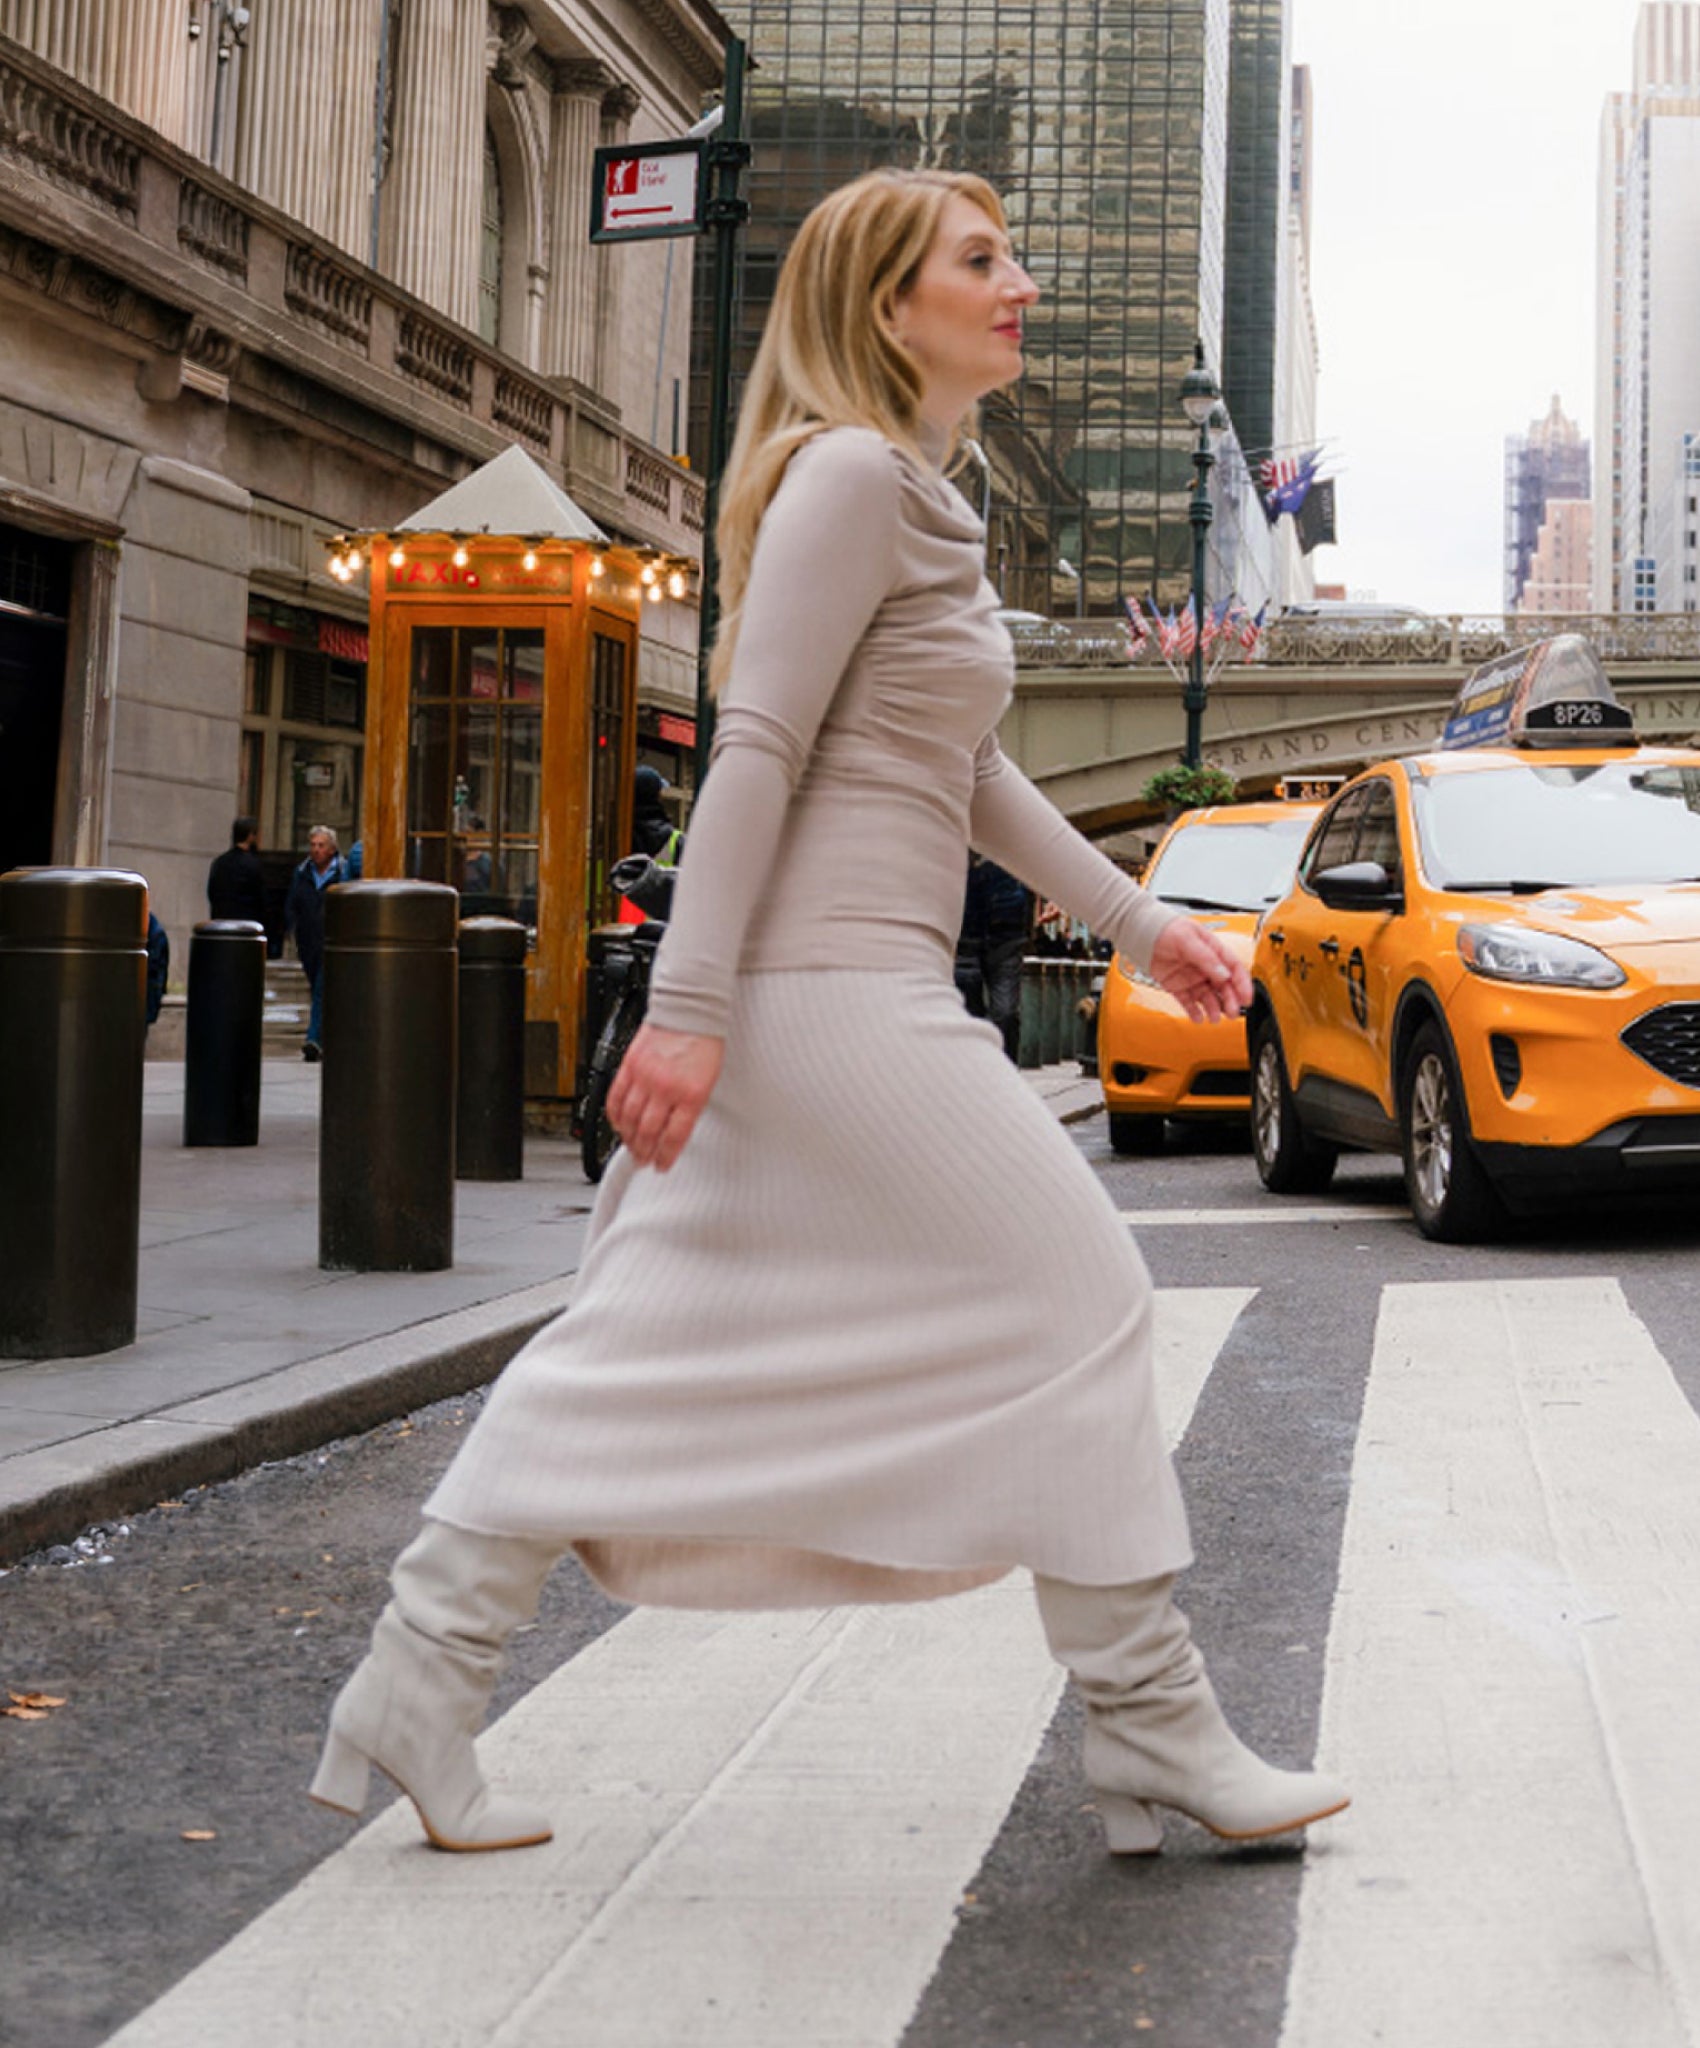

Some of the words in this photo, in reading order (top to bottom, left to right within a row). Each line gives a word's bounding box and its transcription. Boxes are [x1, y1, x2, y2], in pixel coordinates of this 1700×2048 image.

[1554, 703, 1603, 725] 8P26
[1204, 732, 1331, 768] GRAND
[1355, 718, 1444, 746] CENT
